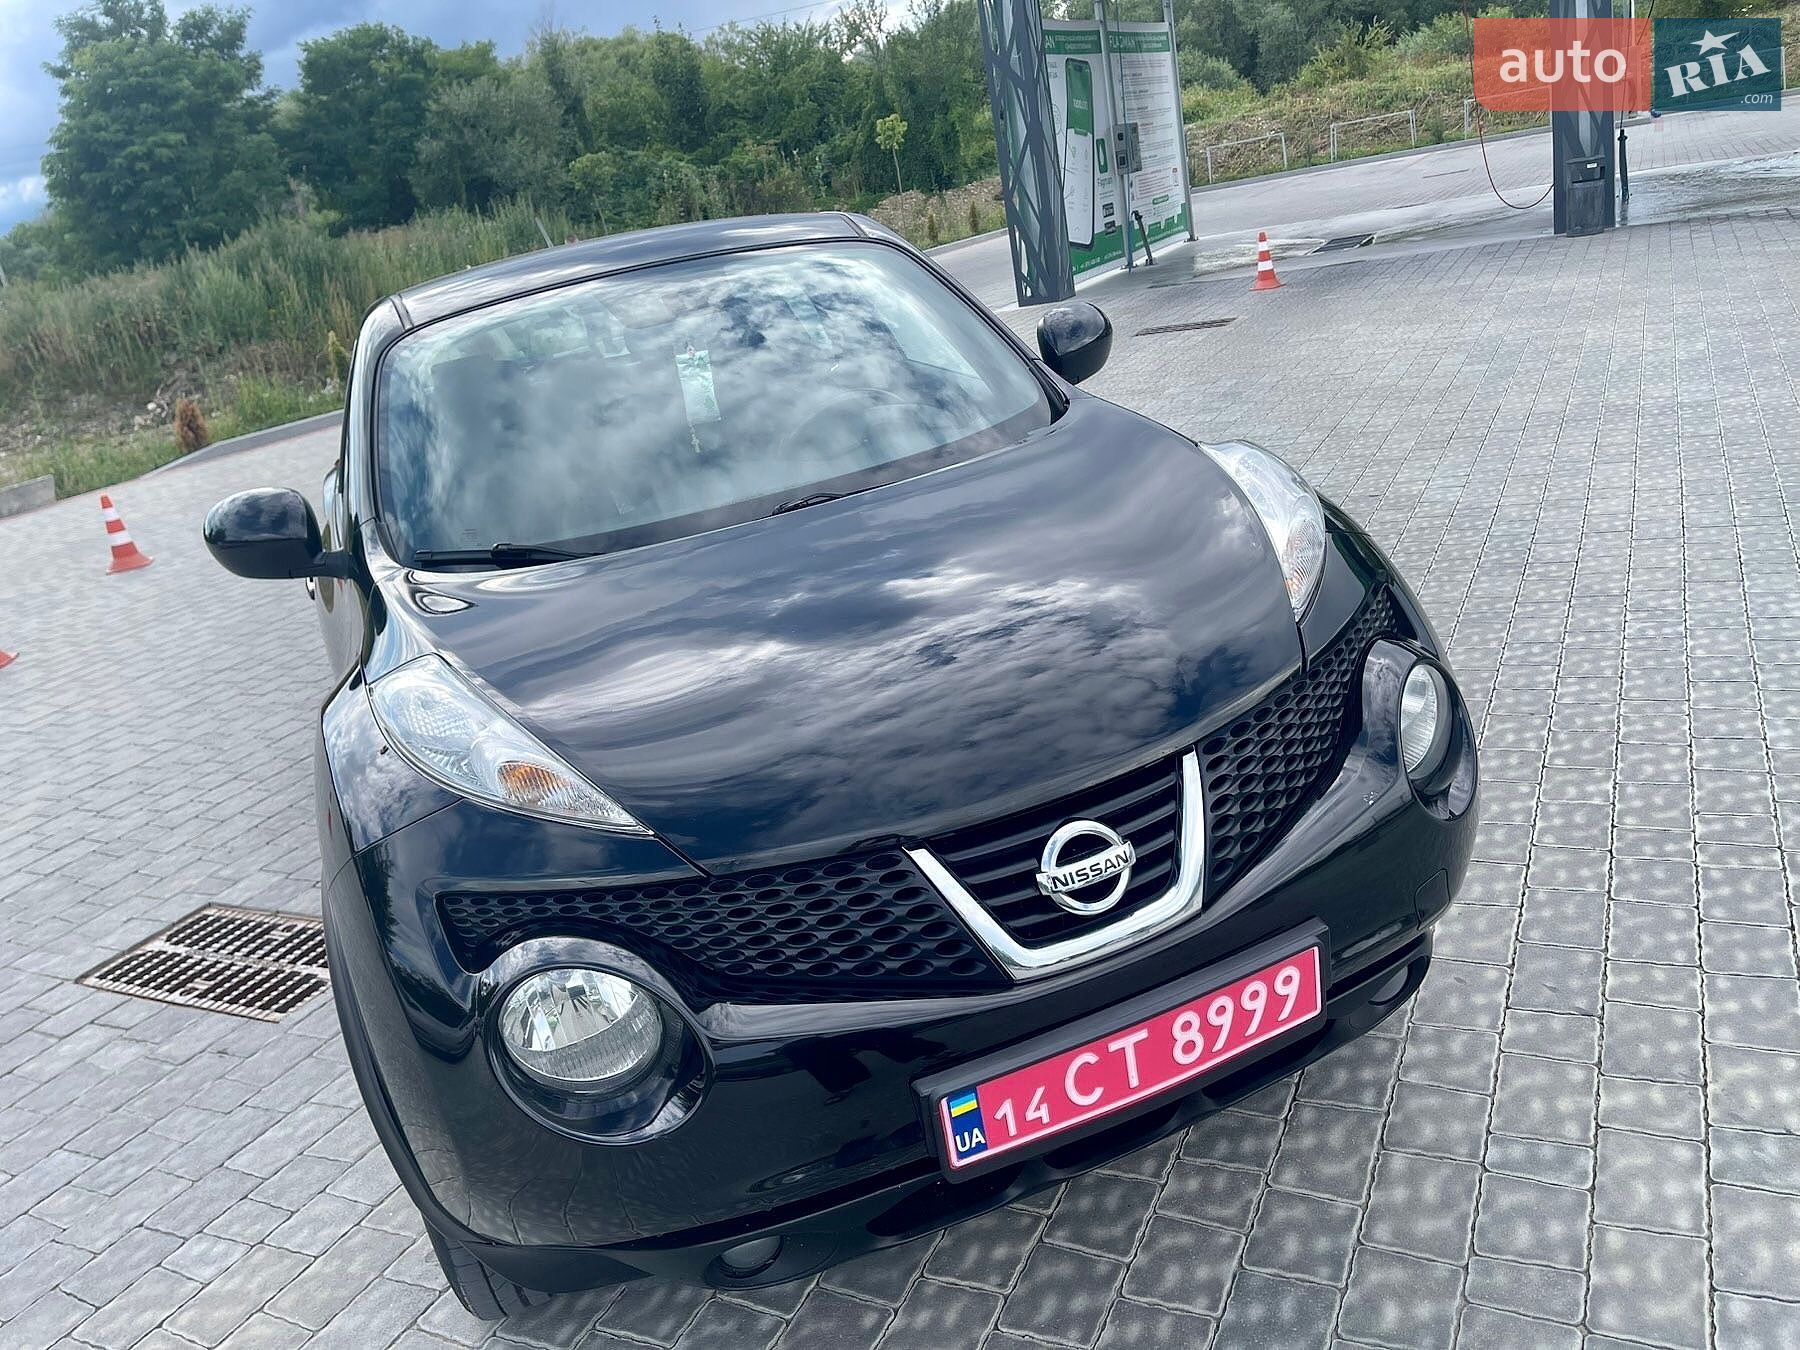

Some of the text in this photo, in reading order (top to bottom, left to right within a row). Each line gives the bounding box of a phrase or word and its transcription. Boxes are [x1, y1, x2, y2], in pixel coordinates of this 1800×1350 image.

[1051, 850, 1129, 889] NISSAN
[994, 965, 1300, 1136] 14 CT 8999
[955, 1127, 985, 1153] UA
